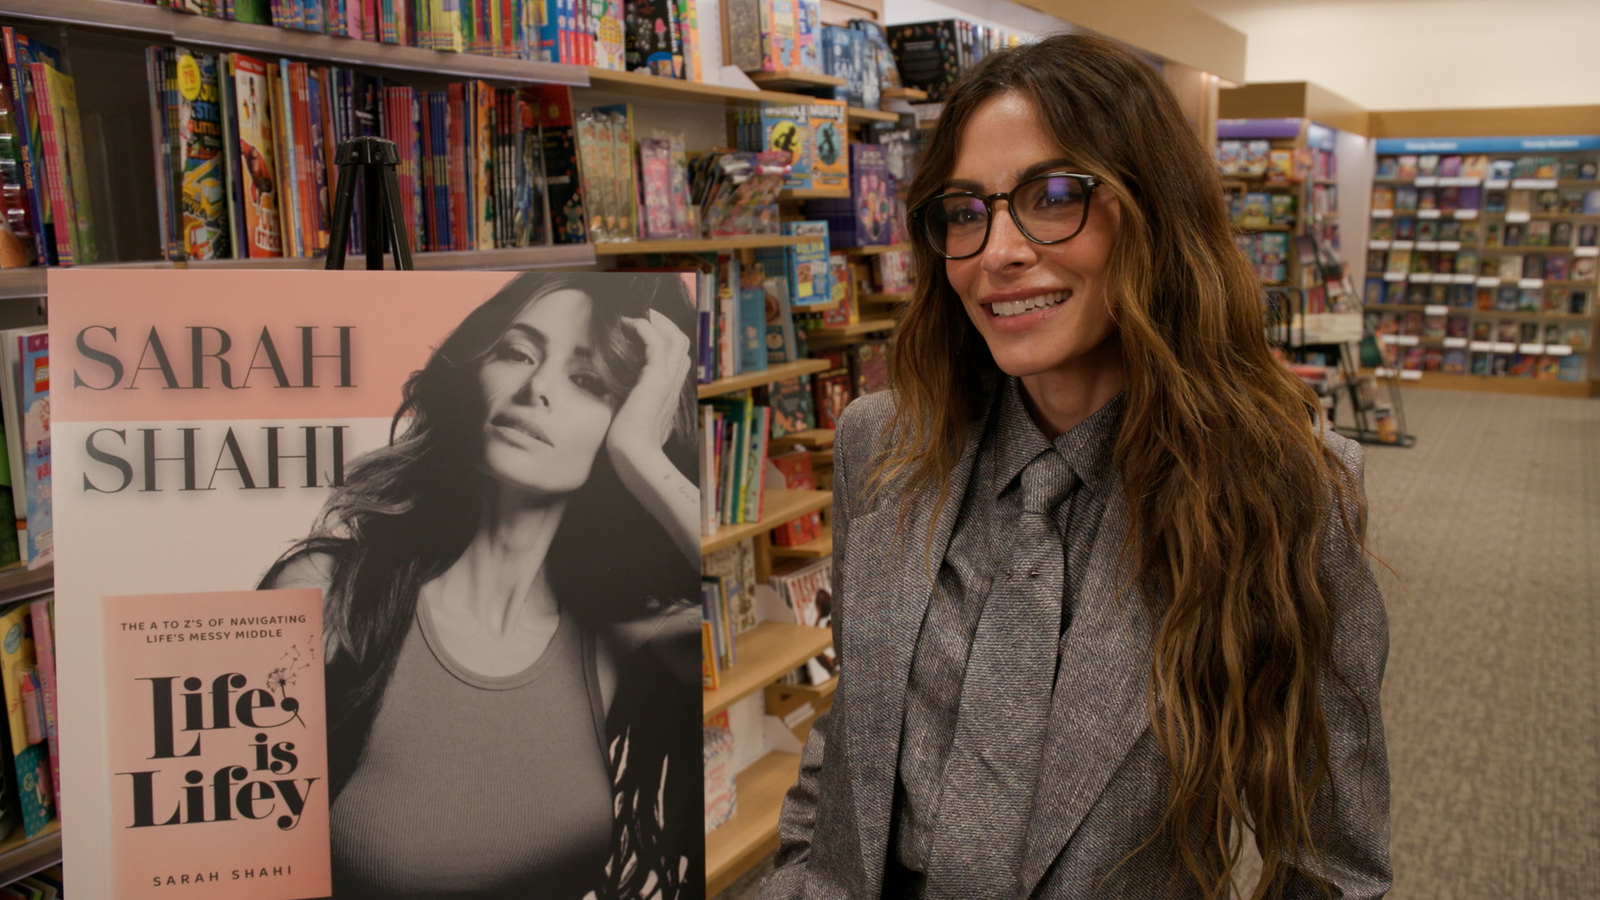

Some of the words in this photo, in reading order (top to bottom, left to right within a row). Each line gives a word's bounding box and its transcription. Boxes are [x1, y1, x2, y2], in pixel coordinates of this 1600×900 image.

[73, 325, 358, 391] SARAH
[83, 425, 350, 493] SHAHI
[120, 622, 145, 631] THE
[150, 621, 158, 630] A
[163, 620, 179, 629] TO
[184, 619, 203, 628] Z'S
[208, 618, 225, 627] OF
[230, 614, 307, 627] NAVIGATING
[146, 633, 185, 643] LIFE'S
[189, 631, 231, 642] MESSY
[235, 628, 283, 640] MIDDLE
[248, 732, 299, 776] is
[114, 765, 321, 831] Lifey
[153, 871, 219, 887] SARAH
[231, 865, 292, 881] SHAHI
